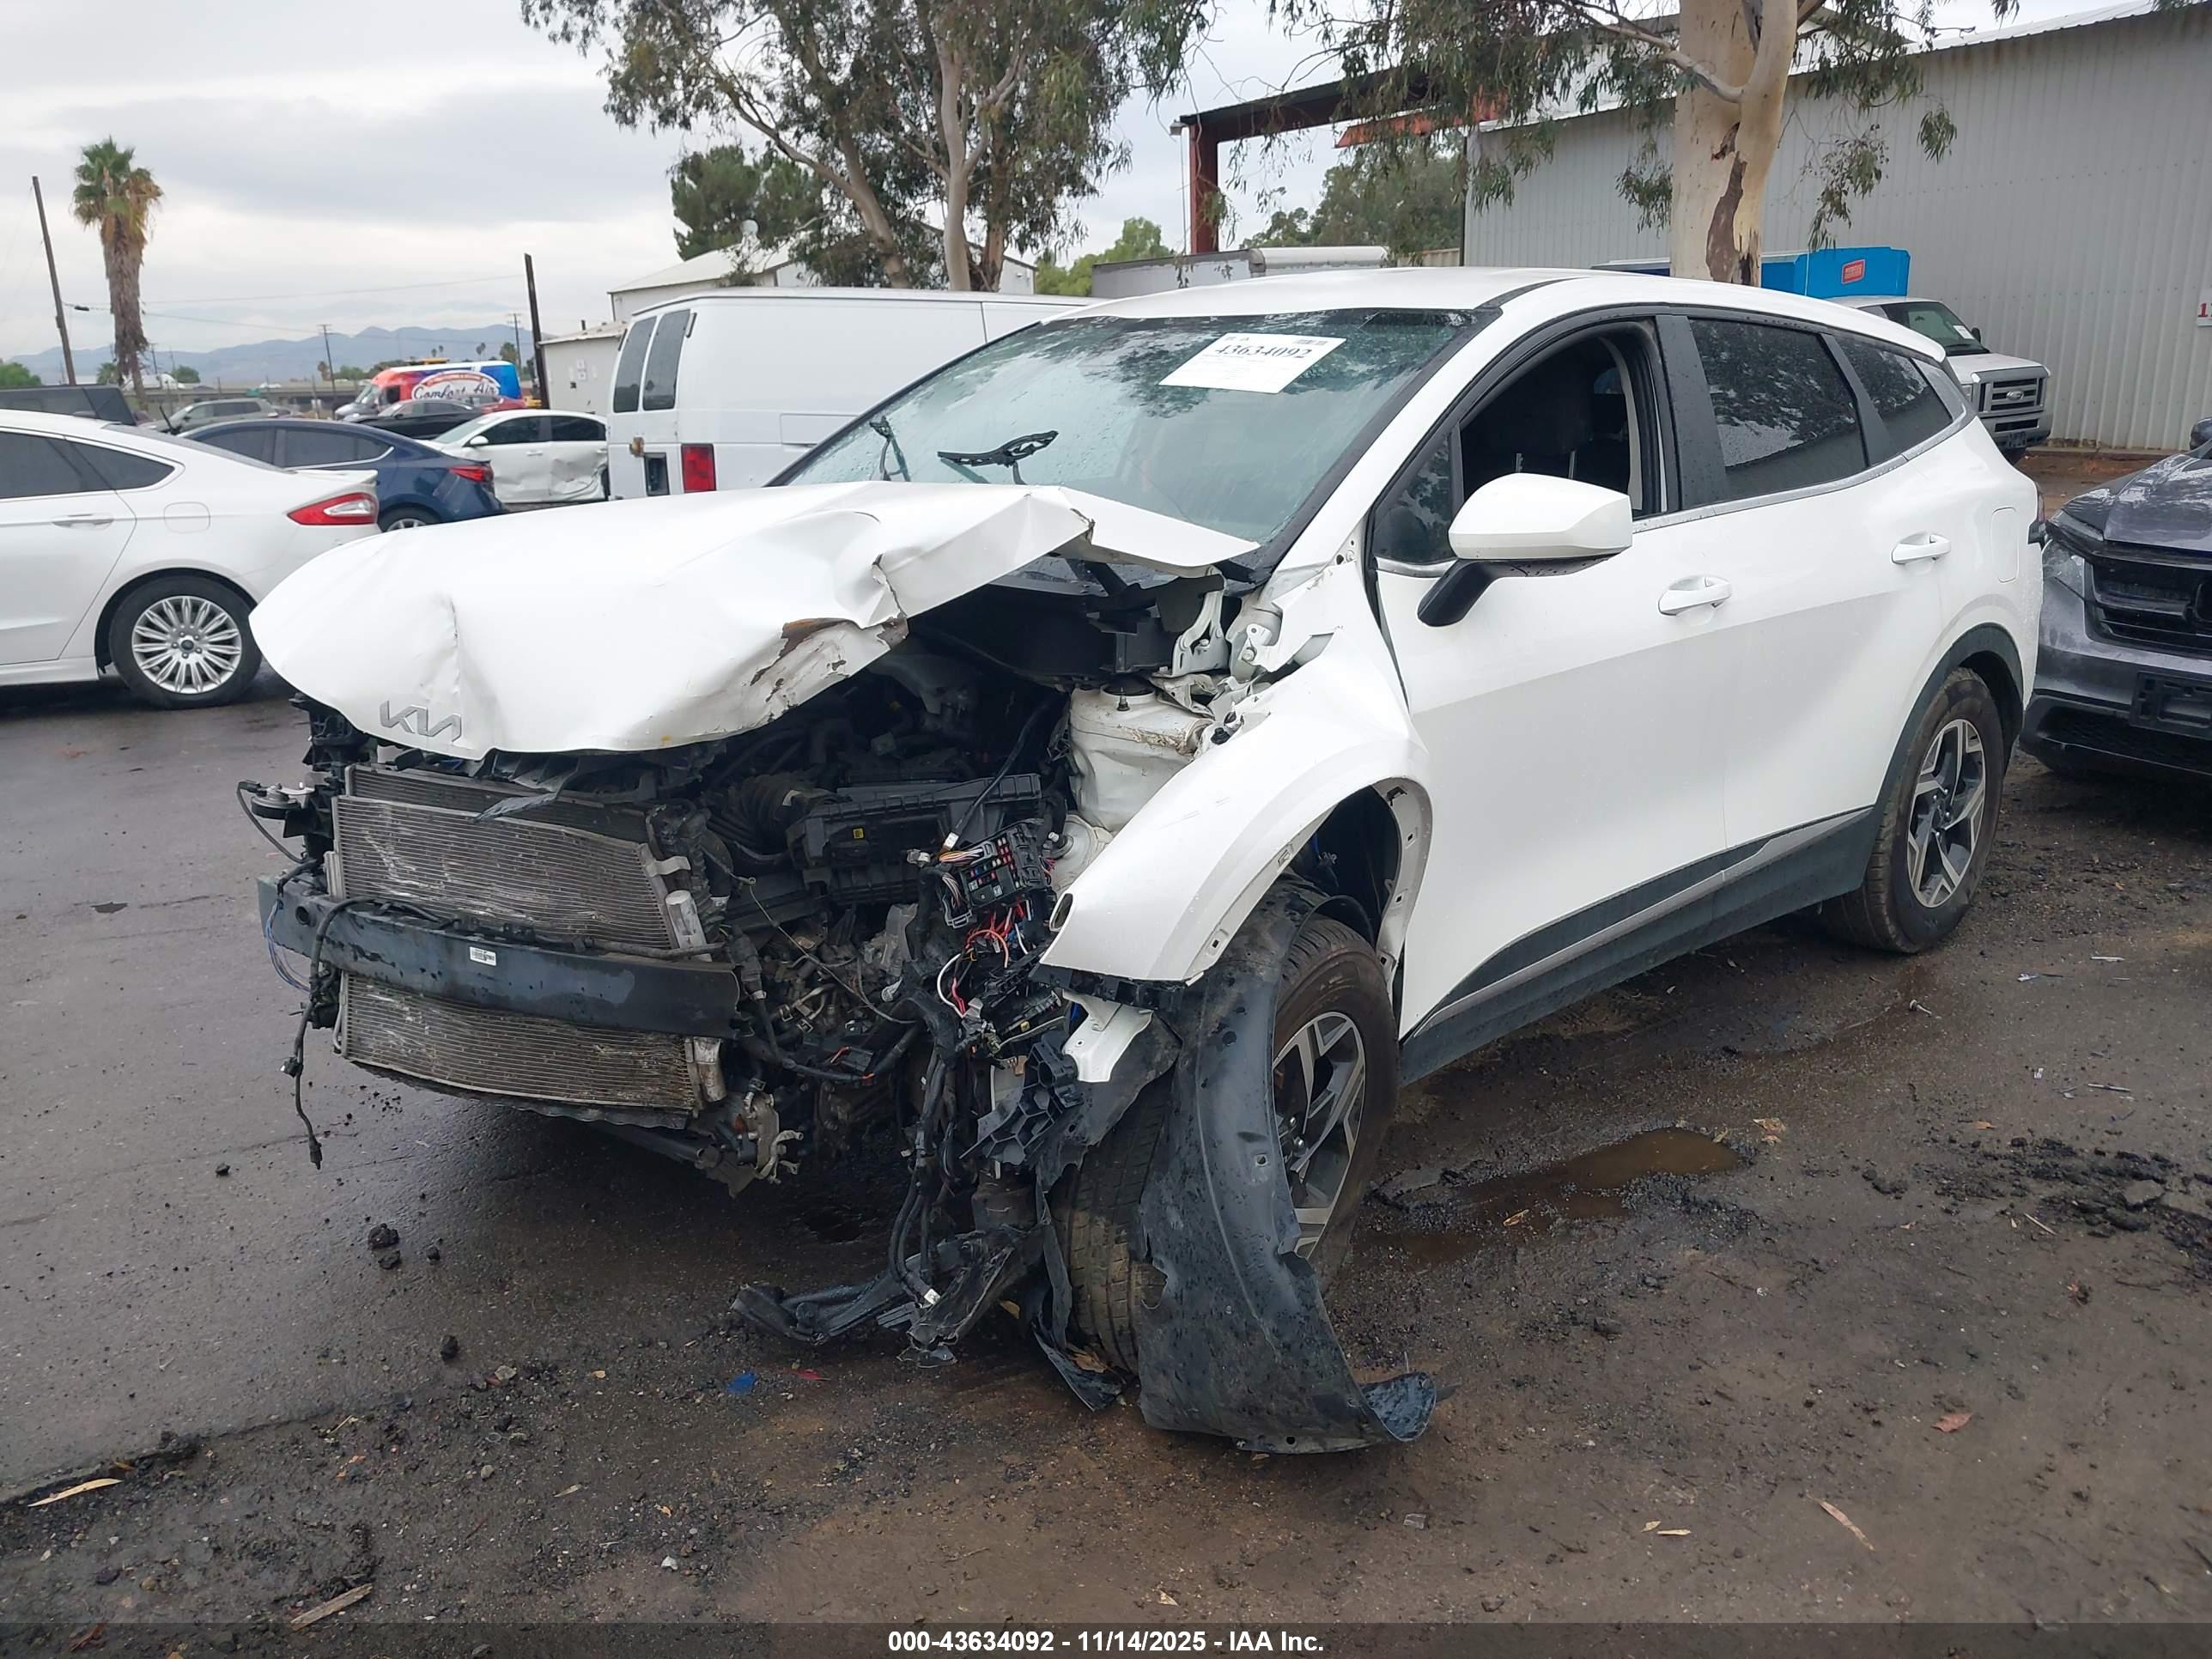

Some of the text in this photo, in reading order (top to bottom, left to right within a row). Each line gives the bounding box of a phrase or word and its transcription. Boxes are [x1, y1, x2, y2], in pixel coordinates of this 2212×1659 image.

[2197, 302, 2212, 318] 1
[1215, 344, 1313, 359] 43634092
[413, 381, 497, 400] Comfort Air
